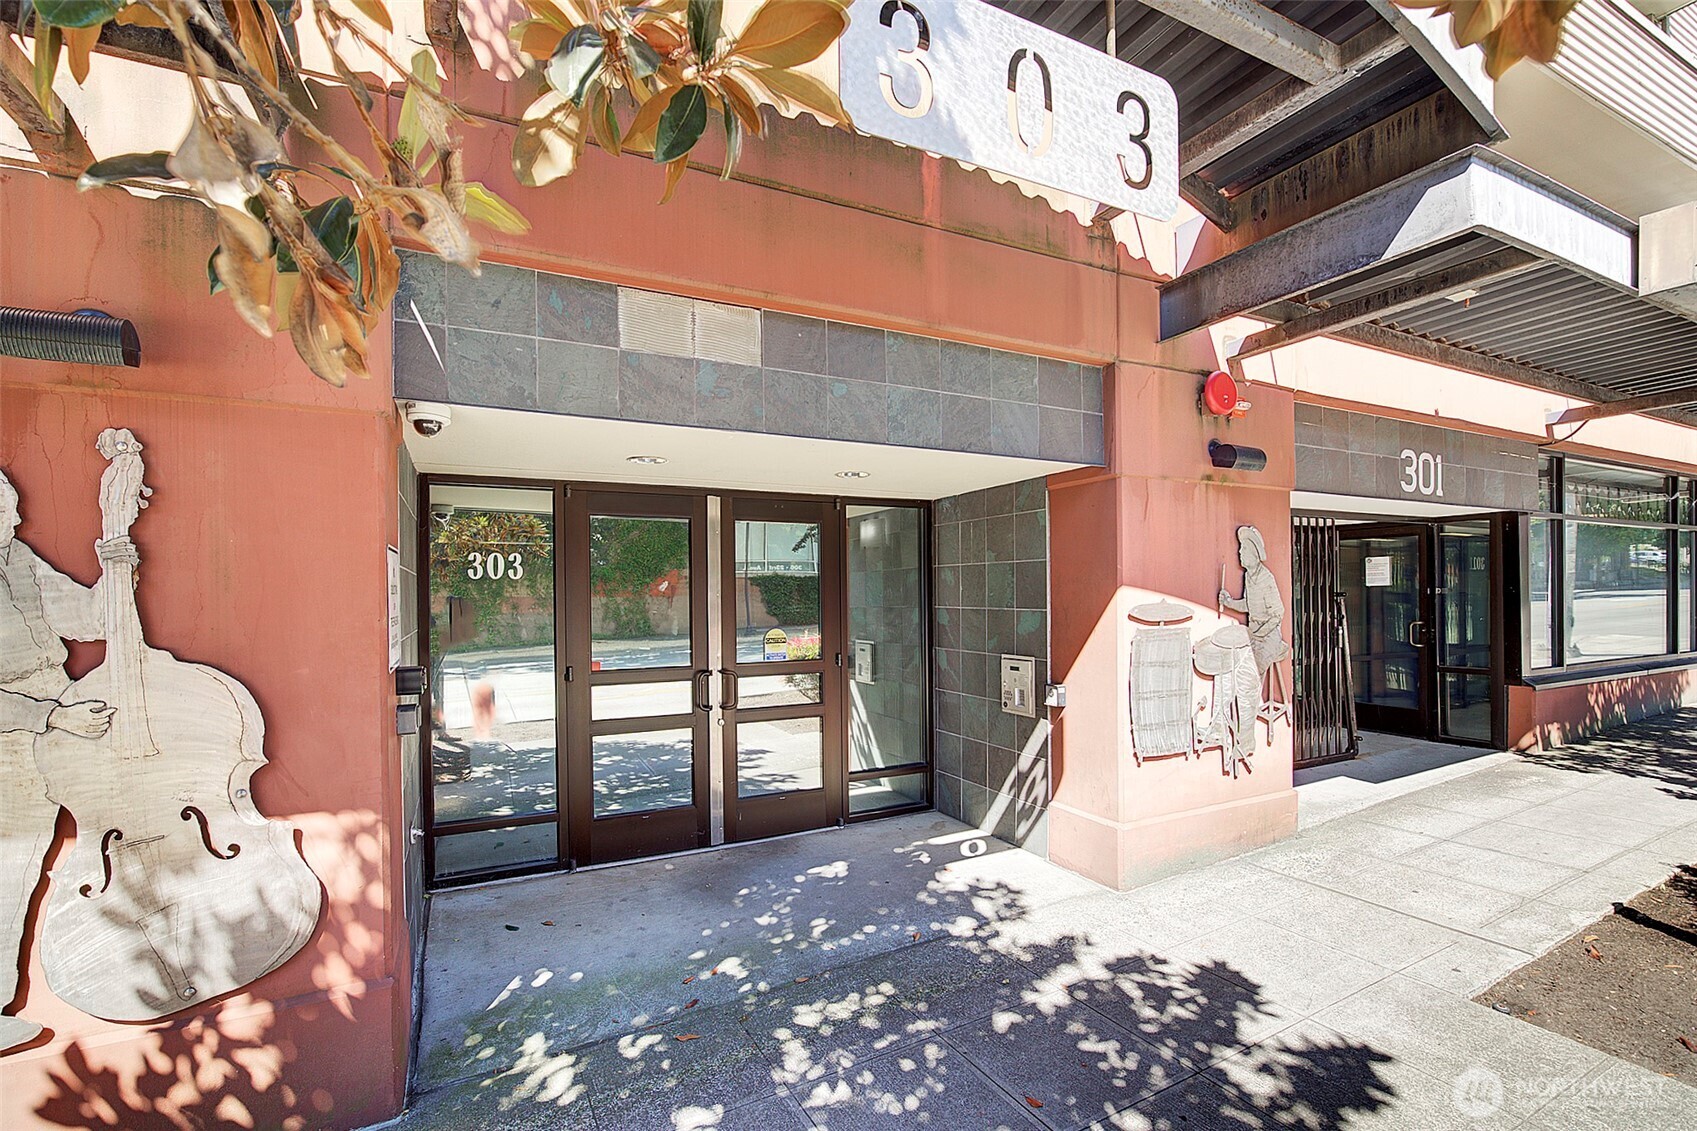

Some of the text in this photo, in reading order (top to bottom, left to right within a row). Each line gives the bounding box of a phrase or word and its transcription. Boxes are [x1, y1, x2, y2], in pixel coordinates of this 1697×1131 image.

[879, 0, 1153, 190] 303
[1400, 448, 1444, 496] 301
[467, 552, 524, 580] 303
